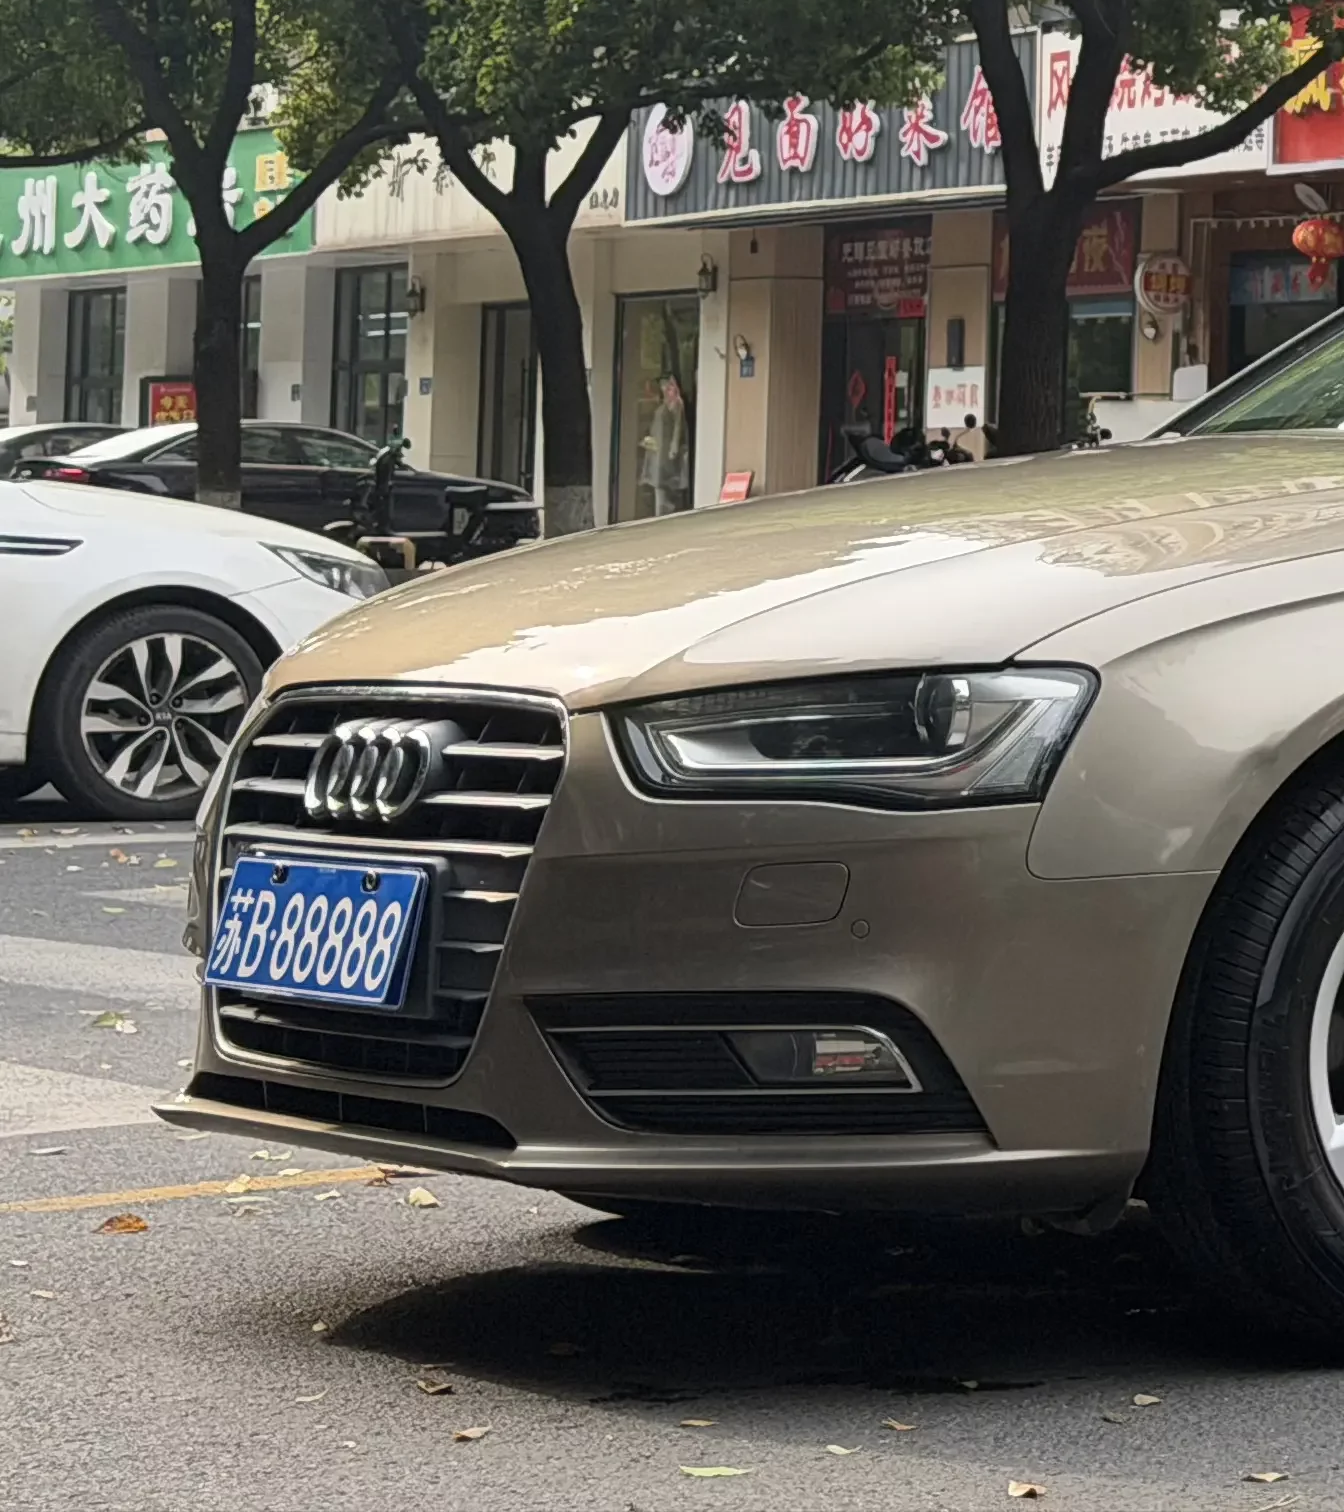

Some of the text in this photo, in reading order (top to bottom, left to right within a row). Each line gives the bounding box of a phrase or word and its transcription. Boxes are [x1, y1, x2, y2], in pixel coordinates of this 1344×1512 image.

[0, 160, 244, 256] 州大药
[212, 888, 402, 992] 苏B·88888
